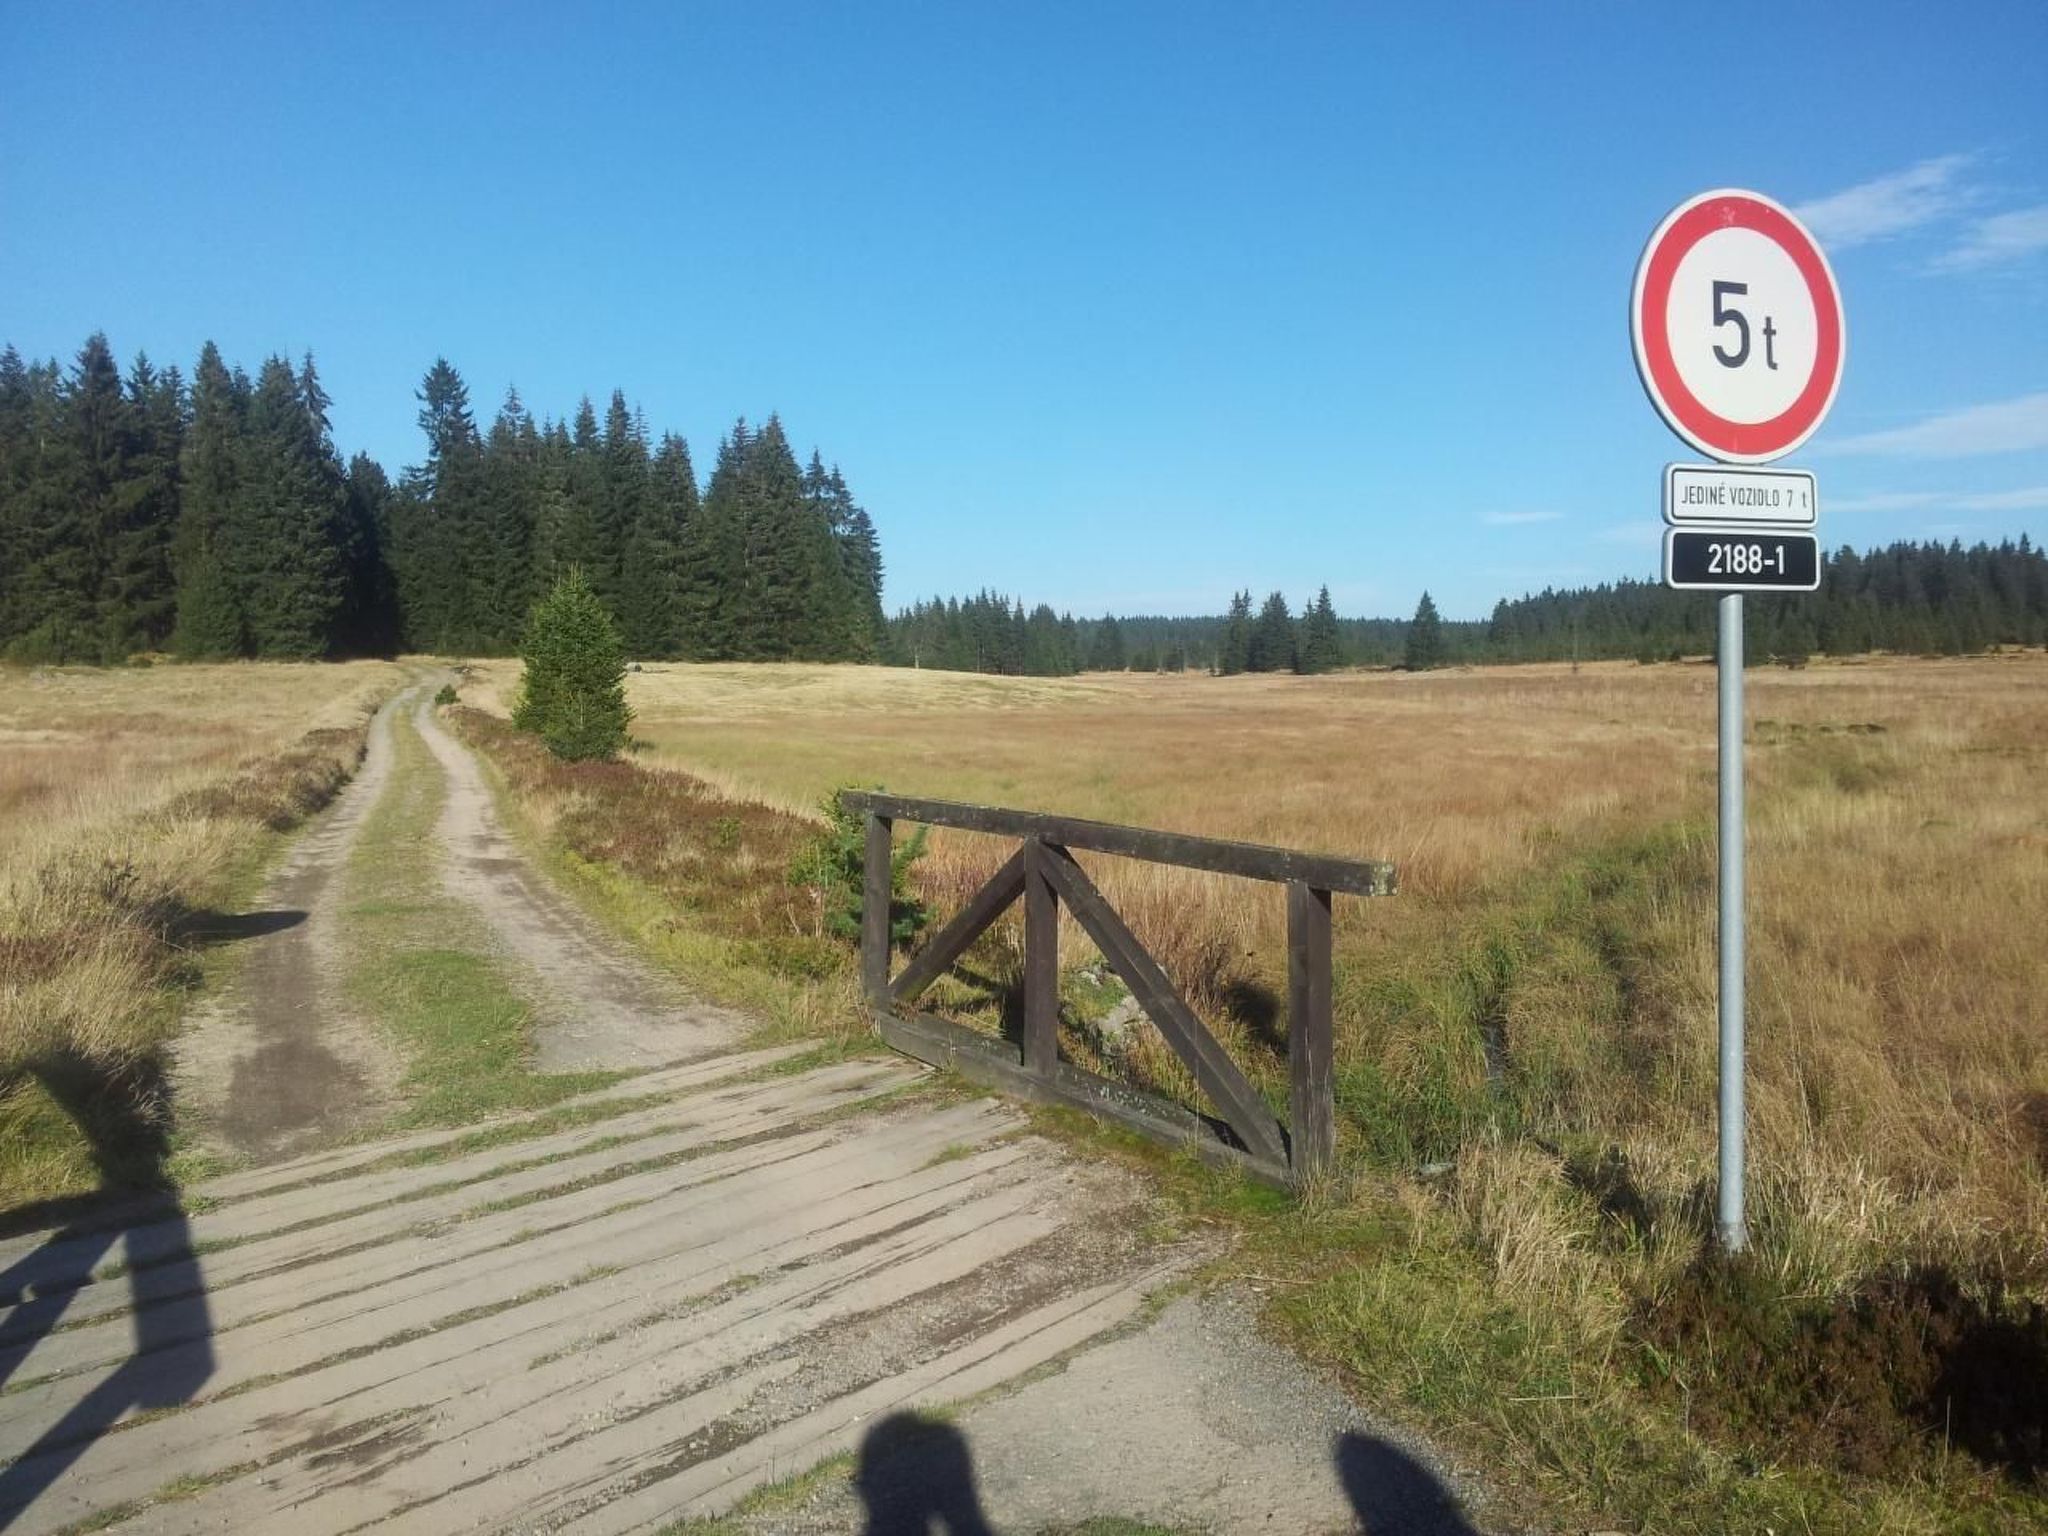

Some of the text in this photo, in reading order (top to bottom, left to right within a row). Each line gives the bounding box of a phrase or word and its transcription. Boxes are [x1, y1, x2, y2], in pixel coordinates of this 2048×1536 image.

[1712, 280, 1779, 370] 5 t
[1681, 482, 1807, 508] JEDINÉ VOZIDLO 7 t
[1708, 543, 1785, 575] 2188-1
